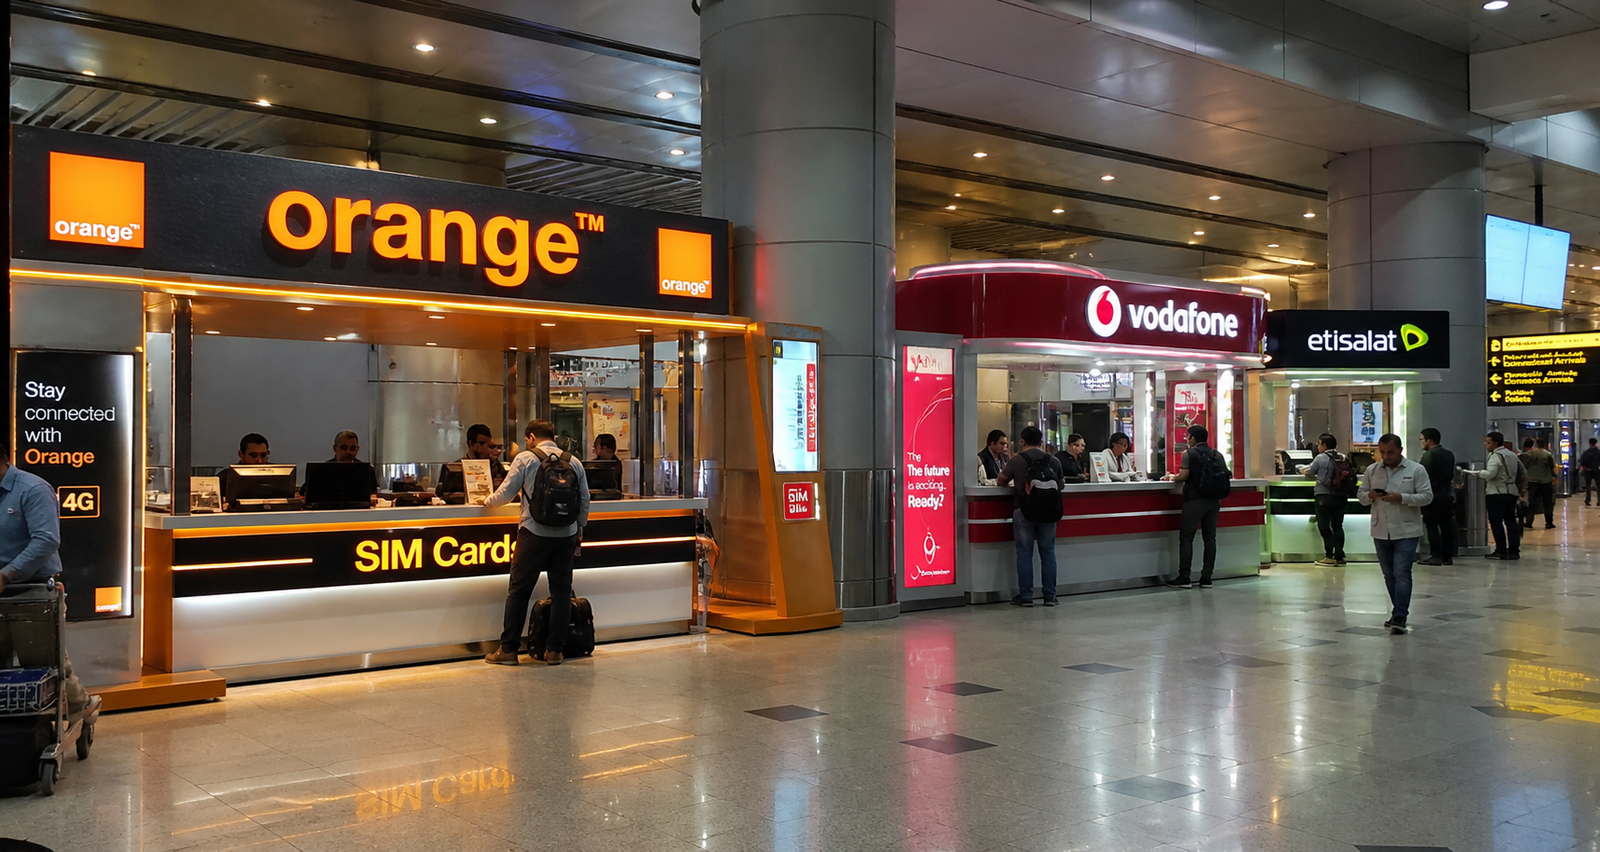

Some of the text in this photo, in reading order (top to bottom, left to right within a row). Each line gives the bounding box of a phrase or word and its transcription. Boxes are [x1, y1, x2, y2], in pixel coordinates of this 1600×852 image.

[1128, 300, 1239, 338] vodafone
[1307, 330, 1398, 352] etisalat
[24, 381, 66, 402] Stay
[24, 406, 116, 422] connected
[24, 427, 62, 443] with
[24, 448, 95, 468] Orange
[907, 464, 950, 477] The future
[62, 492, 95, 512] 4G
[908, 493, 945, 511] Ready?
[354, 538, 424, 572] SIM
